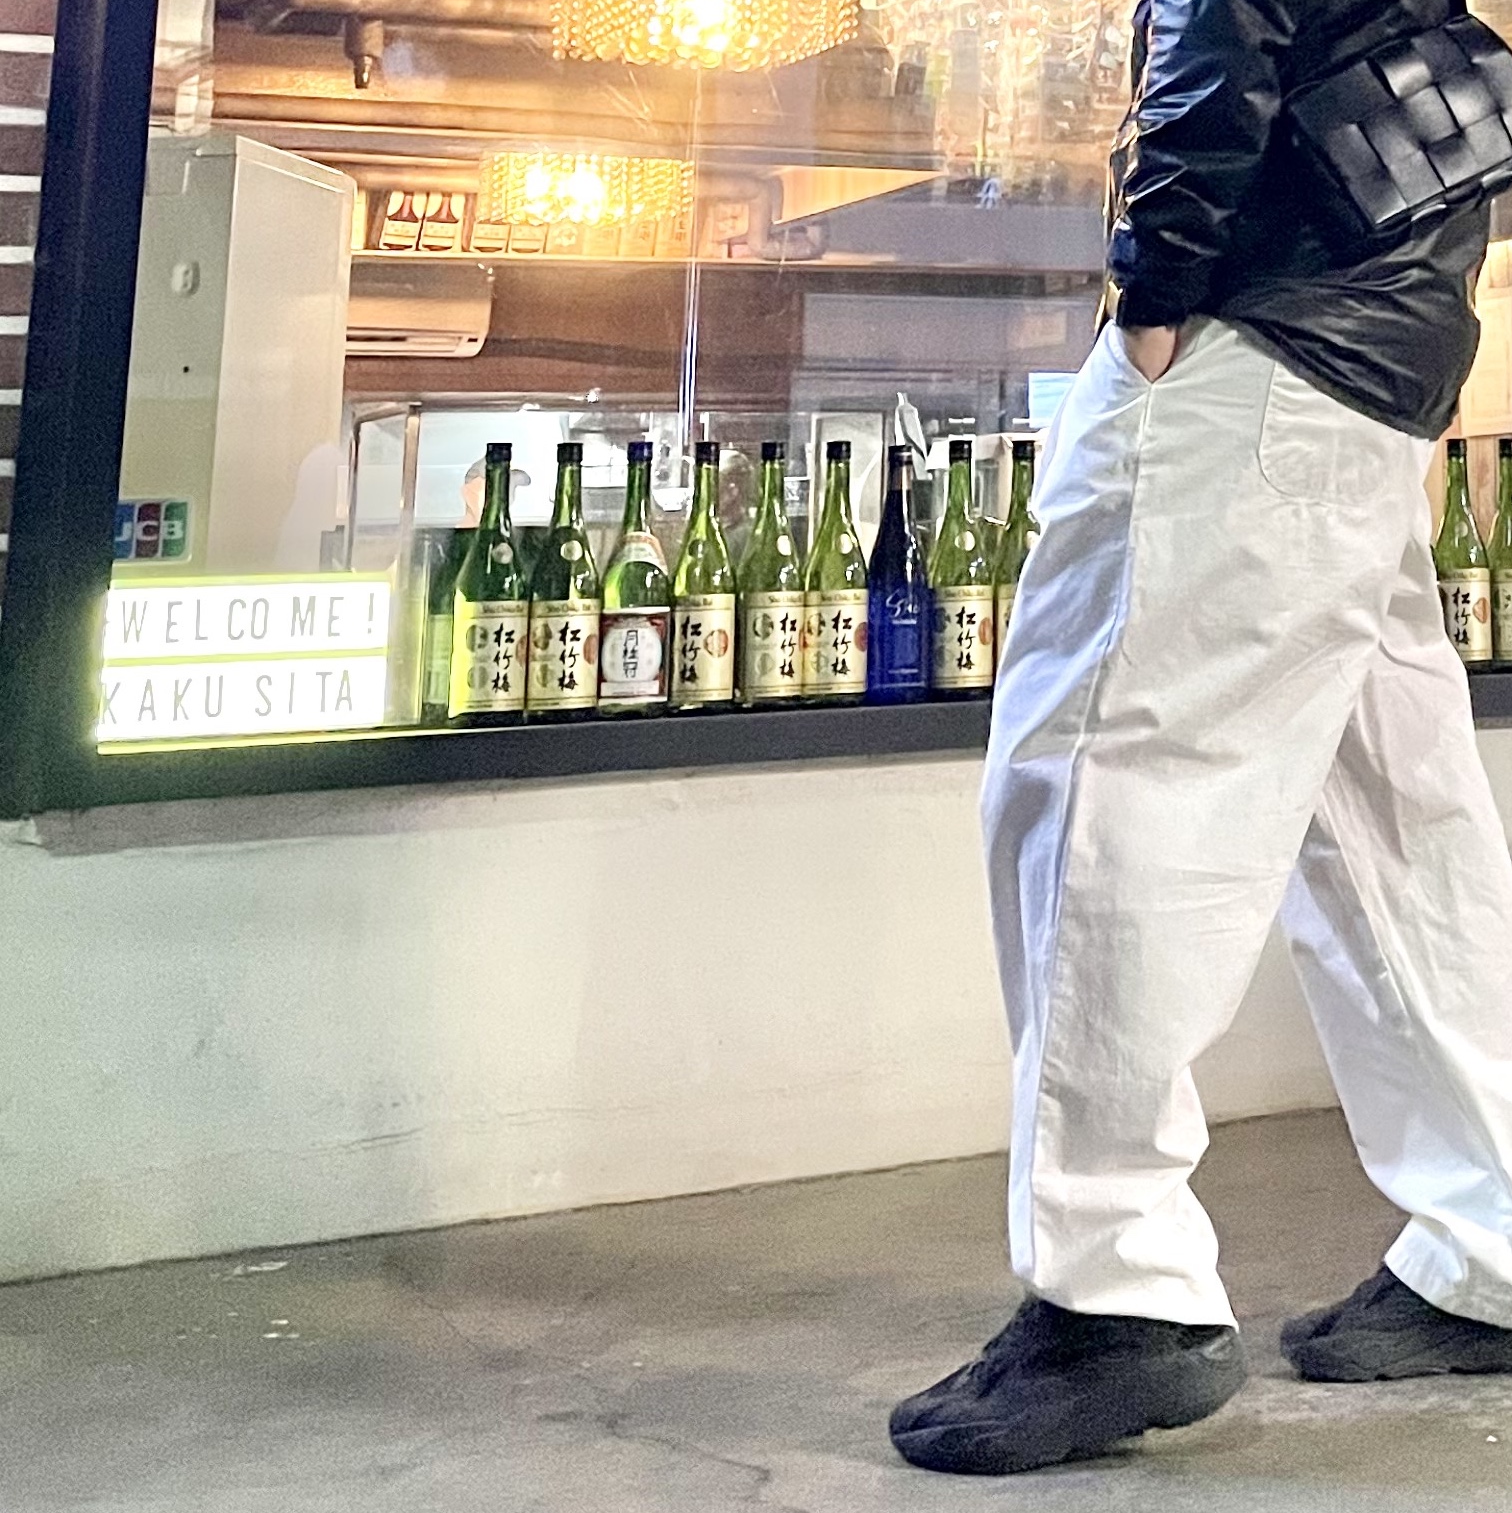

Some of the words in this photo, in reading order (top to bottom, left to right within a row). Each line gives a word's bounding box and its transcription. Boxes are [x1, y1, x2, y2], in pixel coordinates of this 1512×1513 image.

[115, 520, 183, 541] JCB
[492, 622, 515, 693] 松竹梅
[558, 621, 581, 691] 松竹梅
[679, 615, 702, 684] 松竹梅
[779, 612, 797, 678] 松竹梅
[831, 609, 853, 675] 松竹梅
[956, 606, 976, 670] 松竹梅
